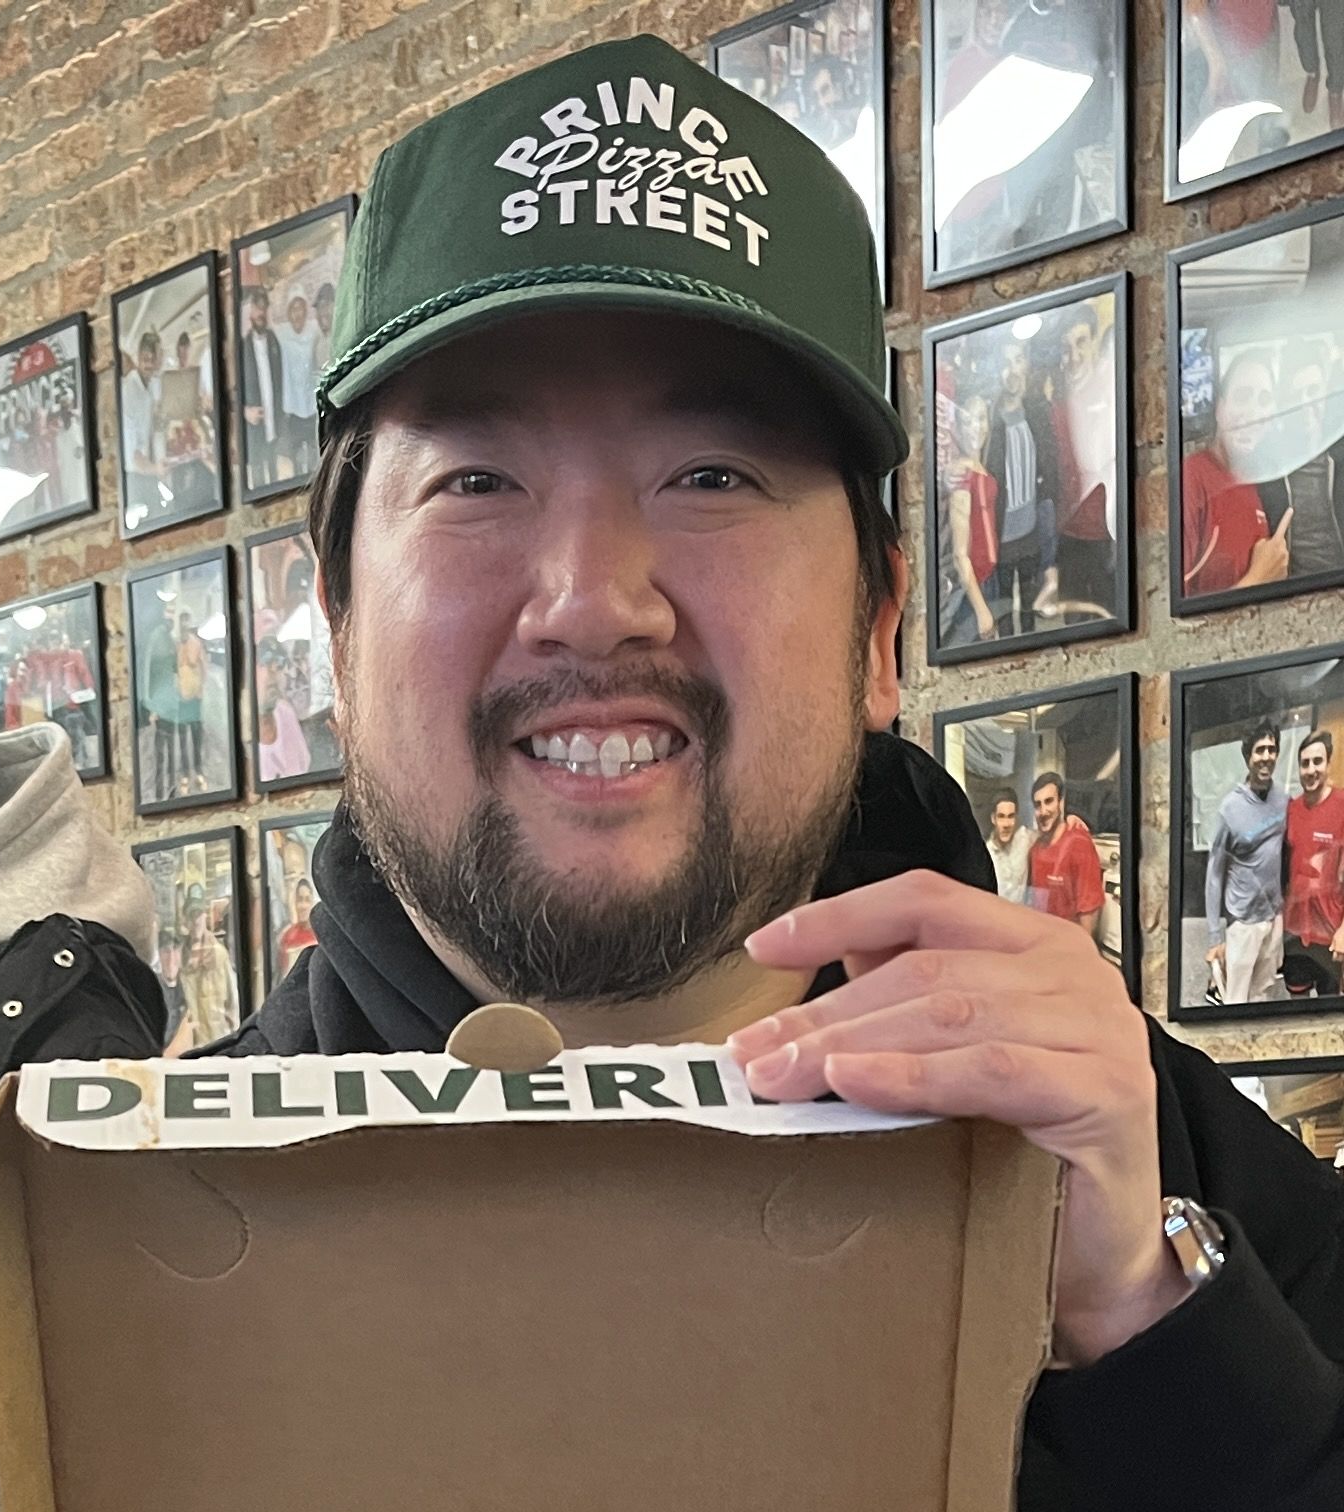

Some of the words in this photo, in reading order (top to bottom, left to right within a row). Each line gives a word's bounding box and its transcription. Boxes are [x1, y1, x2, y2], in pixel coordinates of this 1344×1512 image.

[494, 77, 768, 201] PRINCE
[533, 132, 726, 192] Pizza
[500, 179, 769, 267] STREET
[46, 1059, 847, 1124] DELIVERI
